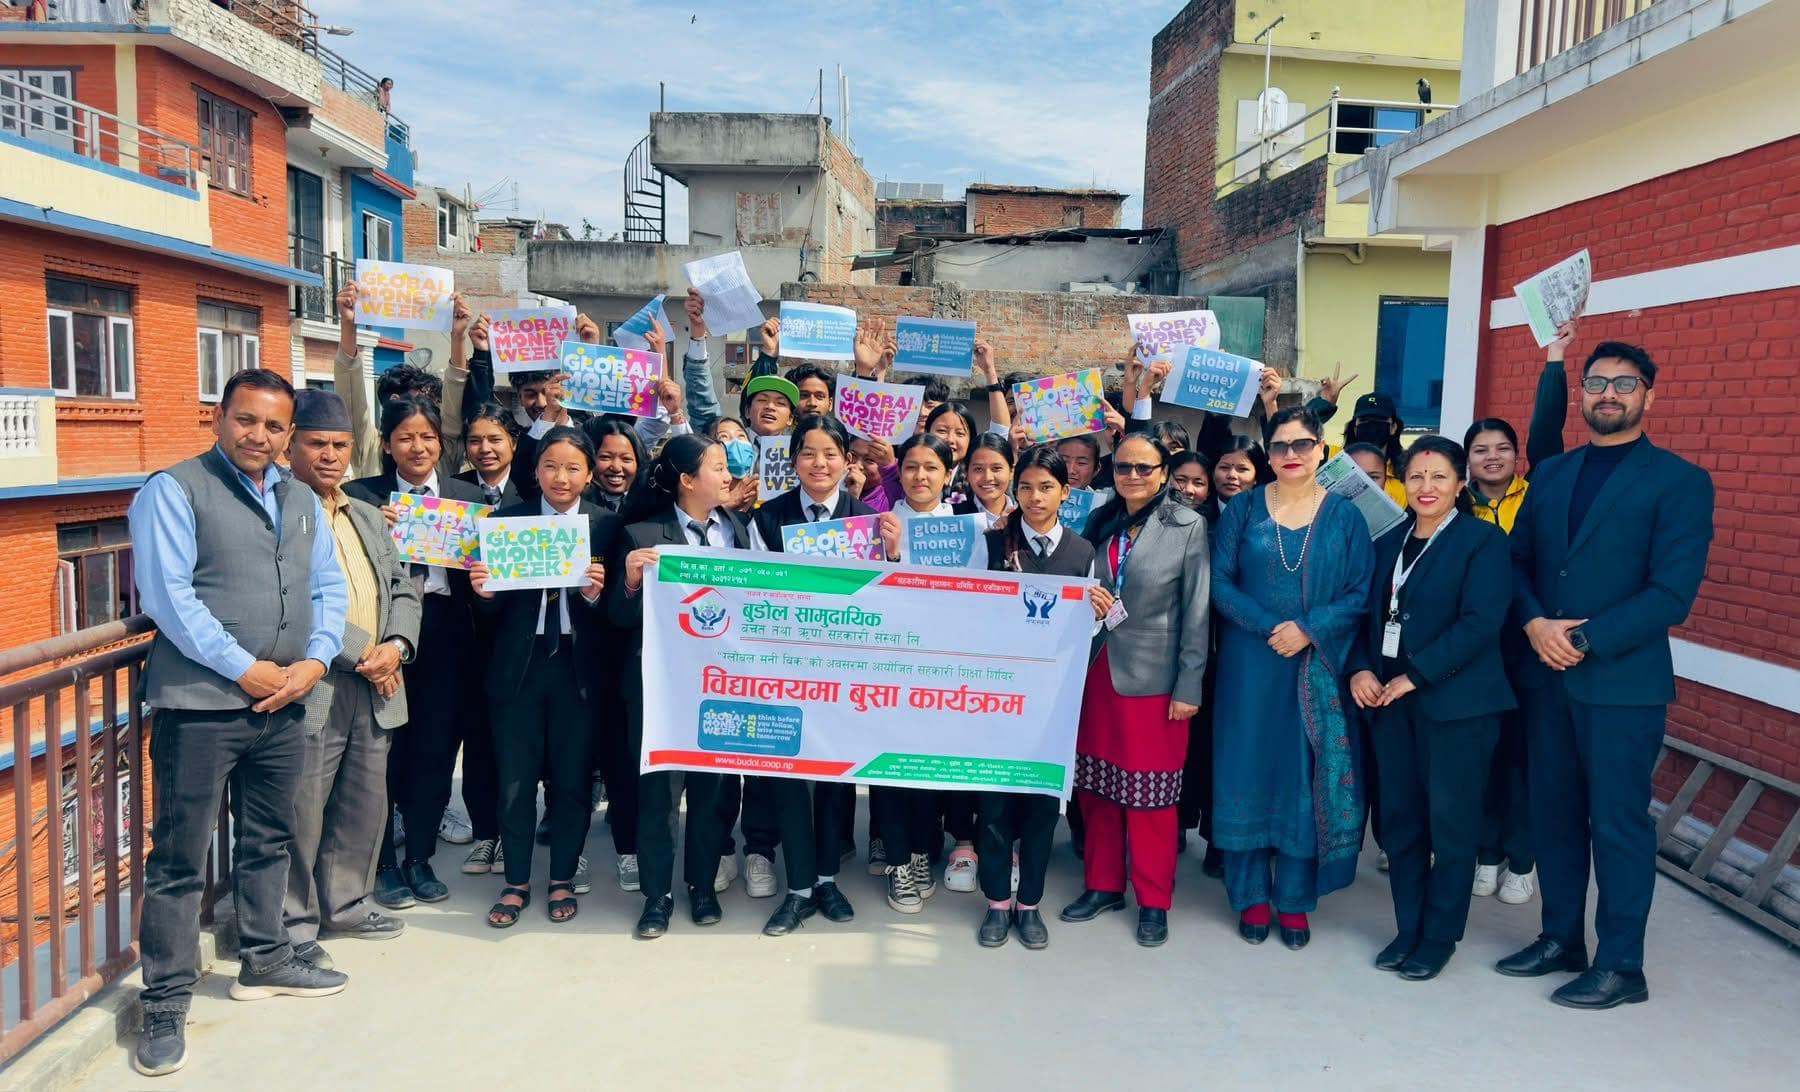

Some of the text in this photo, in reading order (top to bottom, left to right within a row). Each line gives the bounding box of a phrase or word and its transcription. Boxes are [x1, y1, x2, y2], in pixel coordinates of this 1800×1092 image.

[361, 271, 447, 293] GLOBAL
[361, 286, 440, 306] MONEY
[361, 302, 425, 320] WEEK
[493, 317, 573, 334] GLOBAL
[1135, 317, 1207, 332] GLOBAL
[495, 331, 567, 349] MONEY
[1136, 326, 1206, 343] MONEY
[496, 346, 558, 362] WEEK
[564, 354, 658, 380] GLOBAL
[1191, 353, 1240, 374] global
[563, 372, 649, 393] MONEY
[1187, 367, 1237, 389] money
[840, 387, 917, 409] GLOBAL
[1188, 382, 1227, 399] week
[839, 401, 909, 424] MONEY
[1206, 398, 1235, 410] 2025
[486, 528, 583, 547] GLOBAL
[914, 521, 964, 537] global
[787, 527, 881, 554] GLOBAL
[913, 537, 966, 551] money
[487, 544, 576, 563] MONEY
[920, 551, 961, 566] week
[488, 561, 562, 579] WEEK
[743, 599, 883, 628] बुडोल सामुदायिक
[741, 624, 768, 635] बचत
[771, 625, 792, 637] तथा
[828, 628, 869, 643] सहकारी
[874, 631, 901, 646] संस्था
[760, 652, 779, 665] मनी
[826, 659, 868, 671] अवसरमा
[872, 660, 914, 675] आयोजित
[917, 664, 954, 678] सहकारी
[958, 665, 983, 680] शिक्षा
[986, 667, 1016, 682] शिविर
[701, 665, 1026, 716] विद्यालयमा बुसा कार्यक्रम
[703, 711, 747, 723] GLOBAL
[703, 719, 743, 730] MONEY
[746, 714, 757, 738] 2025
[757, 714, 800, 724] think before
[715, 757, 794, 769] www.budol.coop.np
